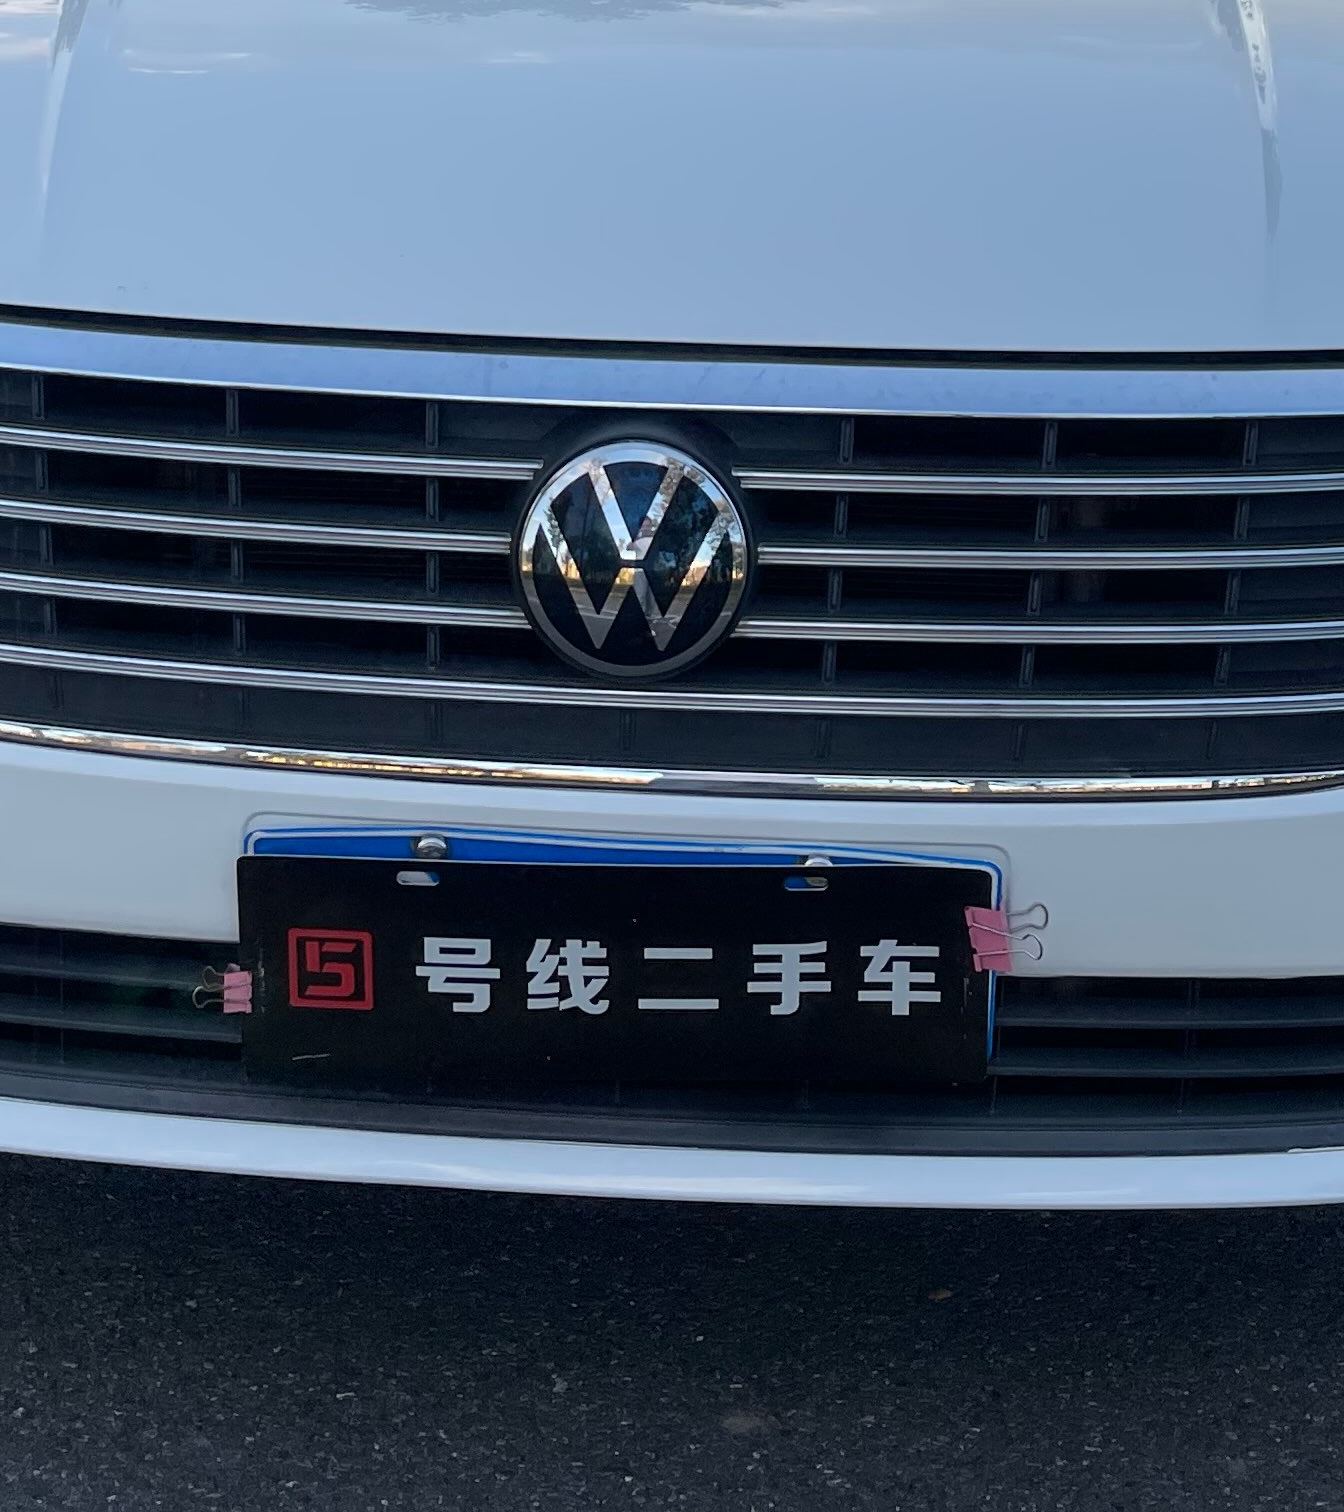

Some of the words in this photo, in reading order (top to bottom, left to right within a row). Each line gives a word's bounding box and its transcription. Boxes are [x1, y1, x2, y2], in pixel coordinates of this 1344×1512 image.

[415, 936, 942, 1016] 号线二手车
